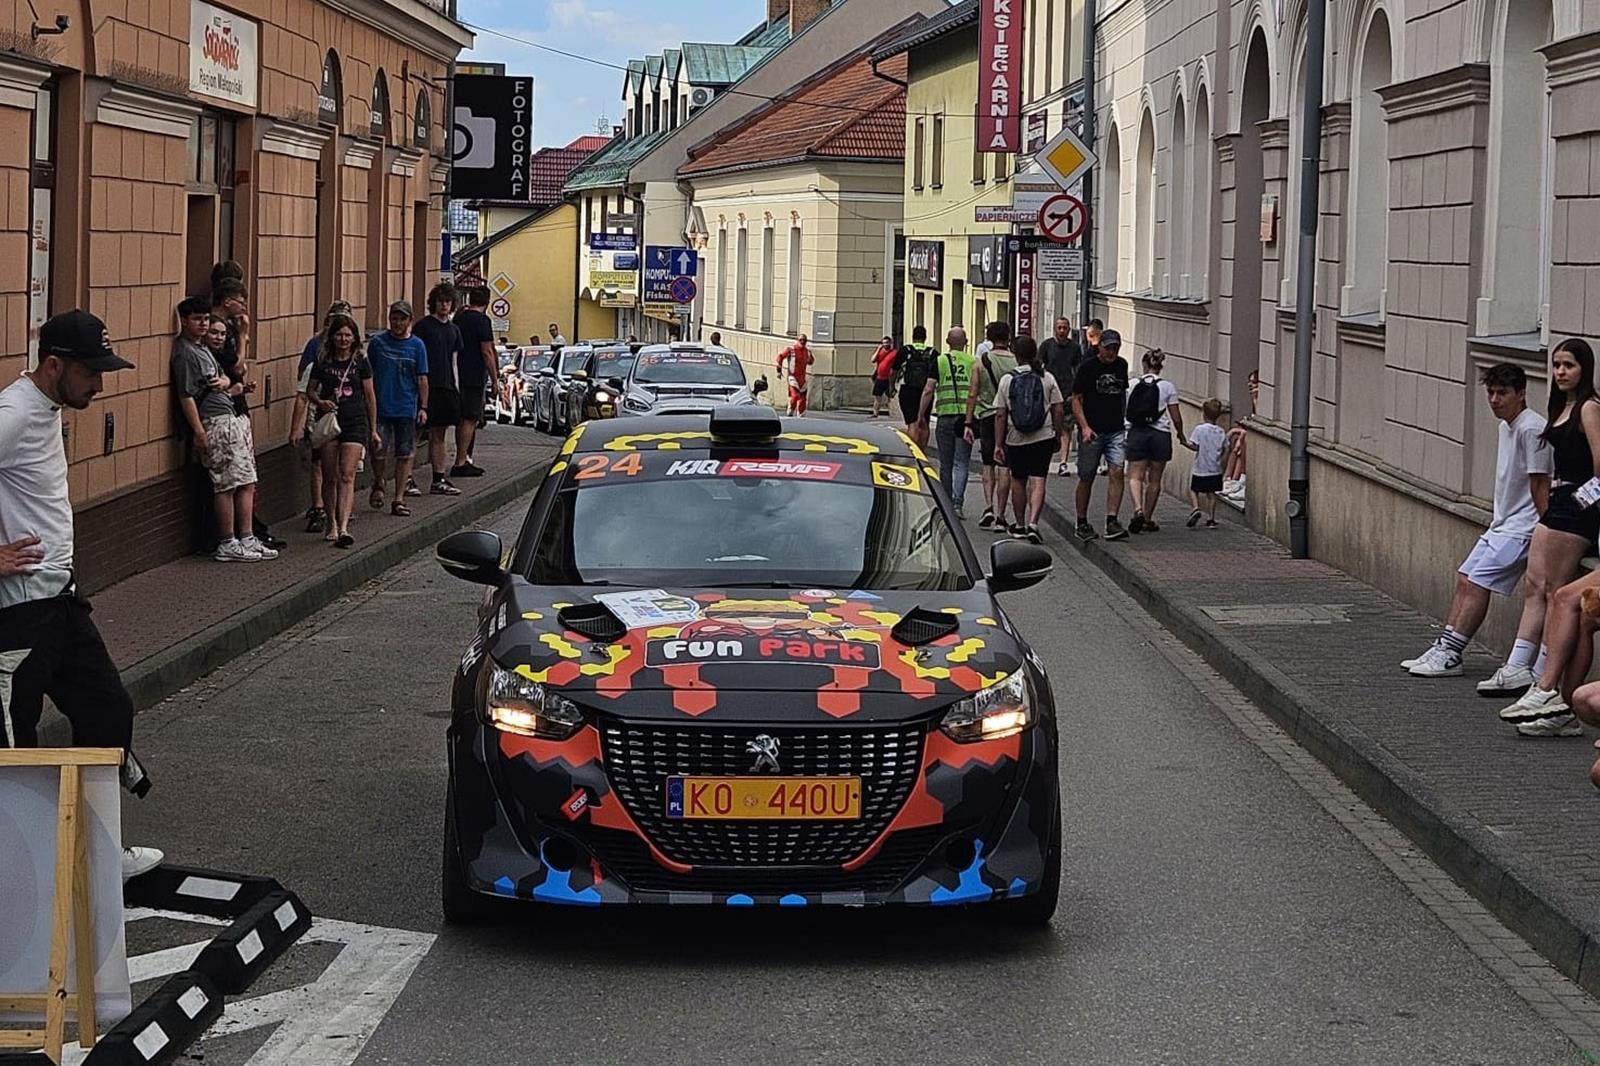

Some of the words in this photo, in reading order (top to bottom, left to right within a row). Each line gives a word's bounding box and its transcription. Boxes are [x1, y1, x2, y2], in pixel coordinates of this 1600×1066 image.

[990, 0, 1011, 148] KSIĘGARNIA
[511, 81, 526, 196] FOTOGRAF
[976, 212, 1037, 222] PAPIERNICZE
[1024, 240, 1063, 249] bankoma
[574, 453, 643, 480] 24
[729, 461, 832, 475] RSMP
[669, 801, 682, 812] PL
